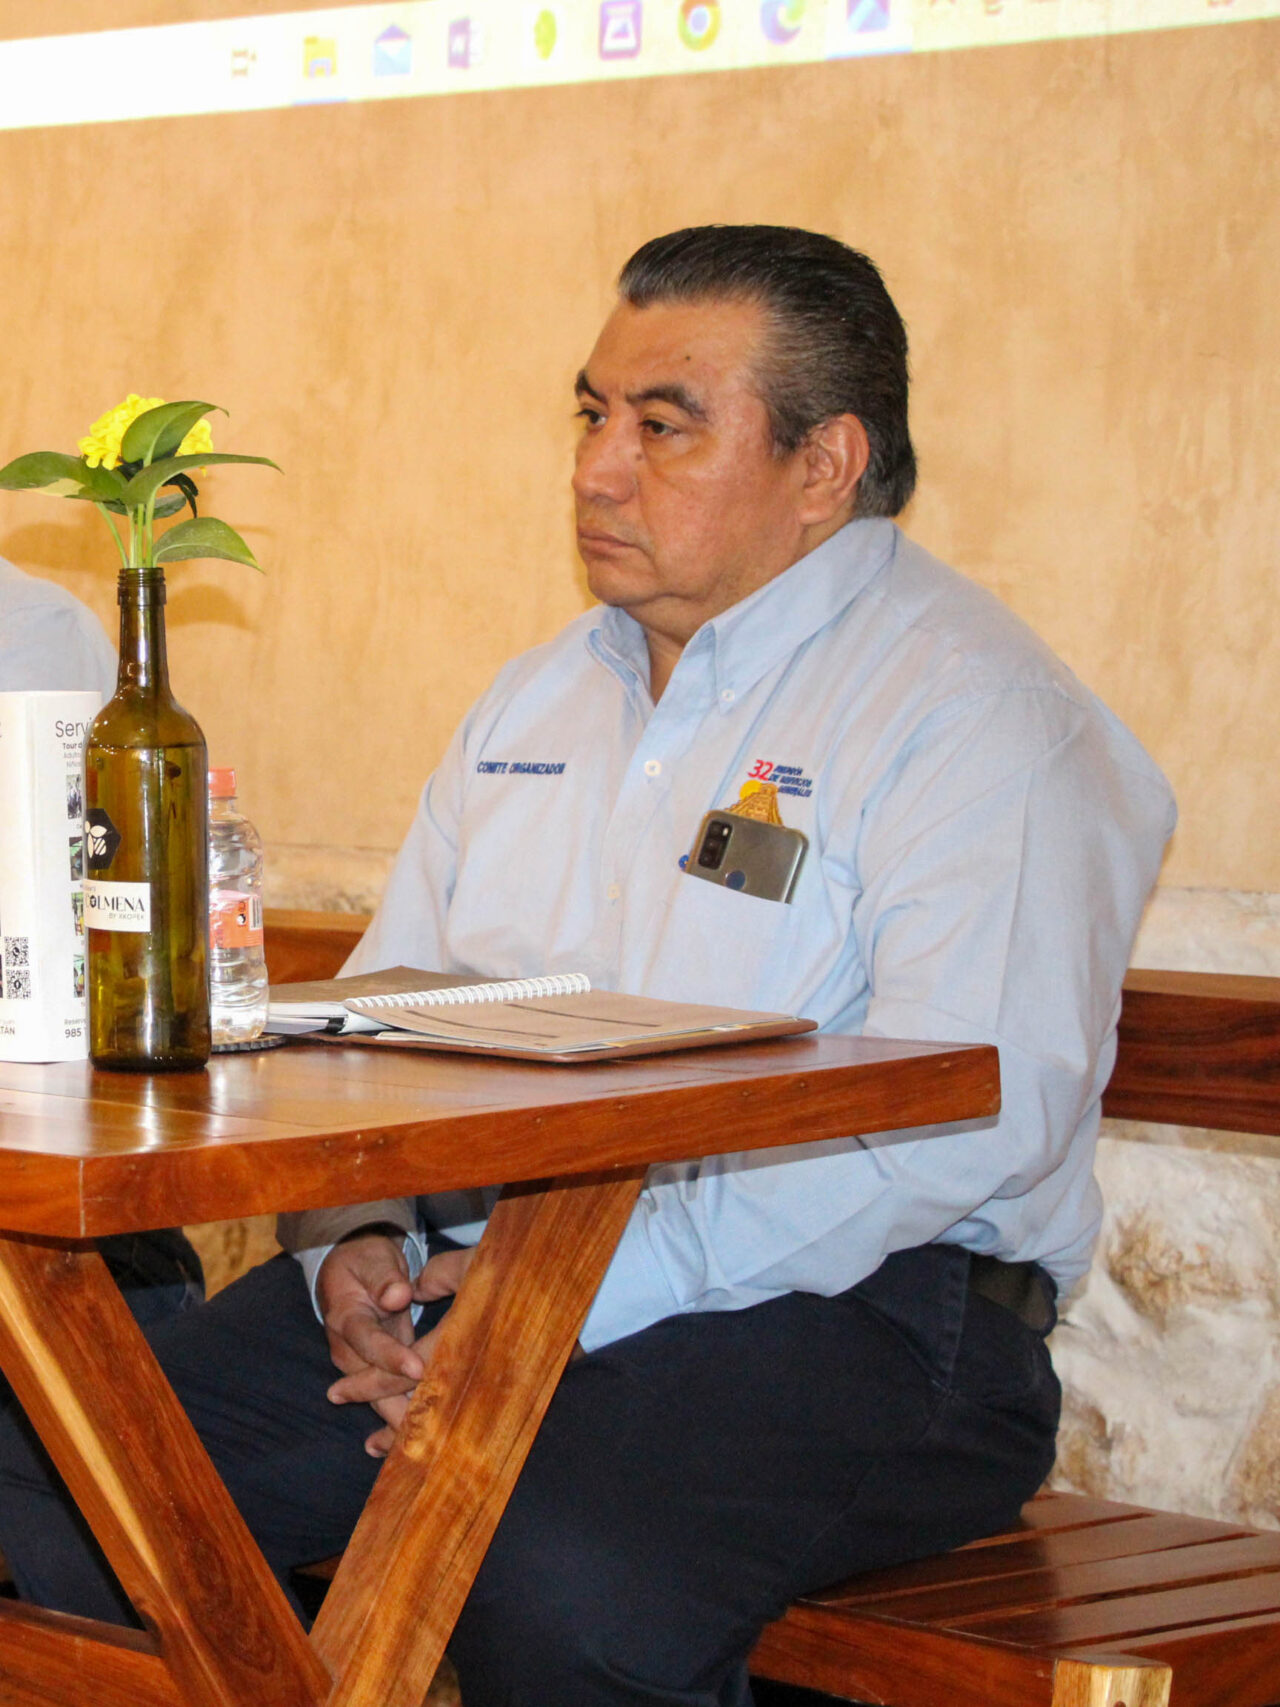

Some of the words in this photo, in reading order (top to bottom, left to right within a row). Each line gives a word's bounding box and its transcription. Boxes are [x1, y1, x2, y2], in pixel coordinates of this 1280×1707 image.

[55, 717, 92, 738] Serv
[747, 759, 774, 781] 32
[65, 1027, 81, 1038] 985
